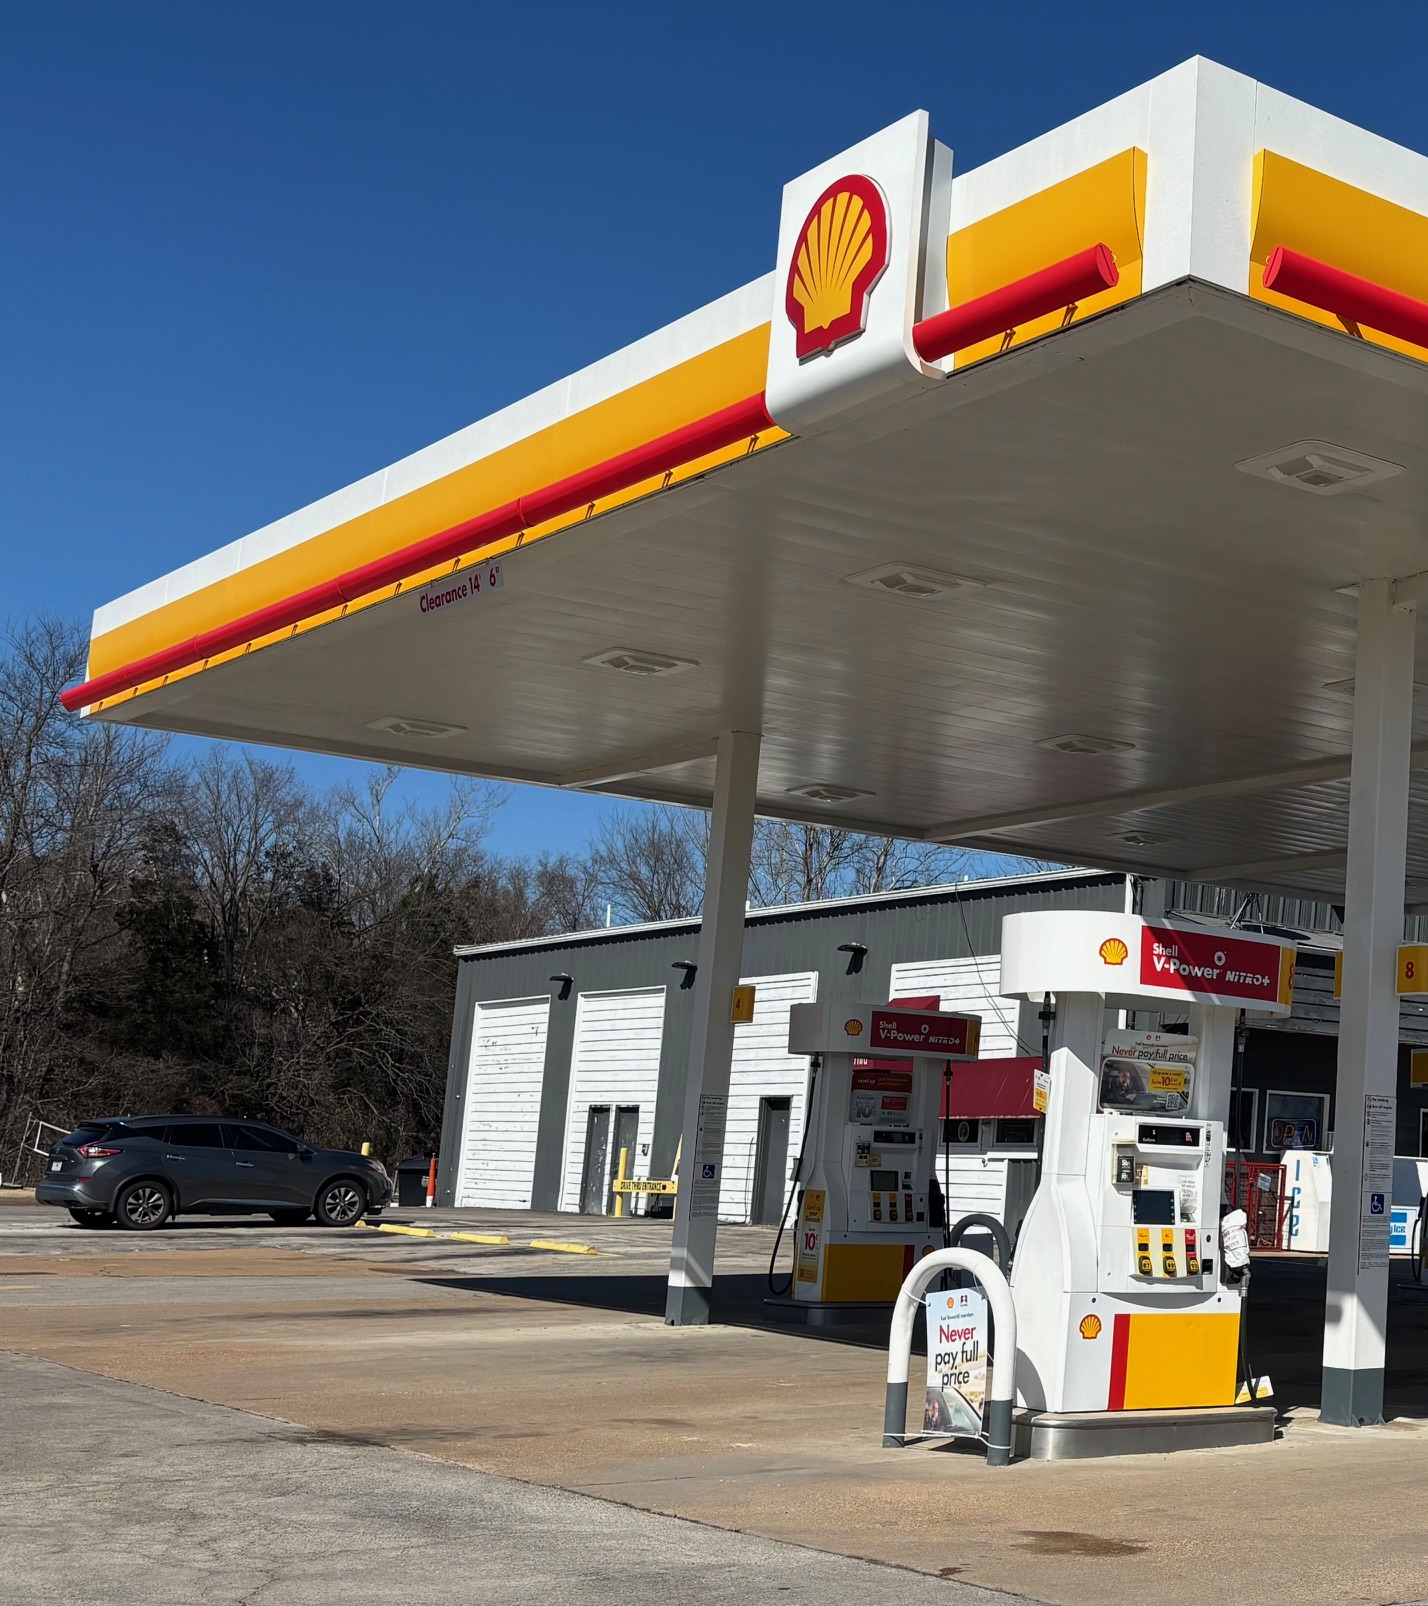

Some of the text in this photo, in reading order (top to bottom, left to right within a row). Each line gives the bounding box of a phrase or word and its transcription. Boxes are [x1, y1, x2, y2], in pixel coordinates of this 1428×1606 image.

[420, 584, 468, 613] Clearance
[1152, 943, 1178, 957] Shell
[1152, 955, 1220, 980] V-Power
[1405, 961, 1414, 980] 8
[736, 998, 741, 1010] 4
[879, 1021, 897, 1030] Shell
[879, 1029, 926, 1042] V-Power
[1112, 1045, 1188, 1062] Never pay full price
[1161, 1077, 1171, 1087] 10
[1273, 1124, 1313, 1143] OPEN
[620, 1181, 632, 1190] DRIVE
[641, 1182, 662, 1192] ENTRANCE
[939, 1324, 976, 1344] Never
[935, 1340, 979, 1372] pay full
[941, 1366, 970, 1393] price
